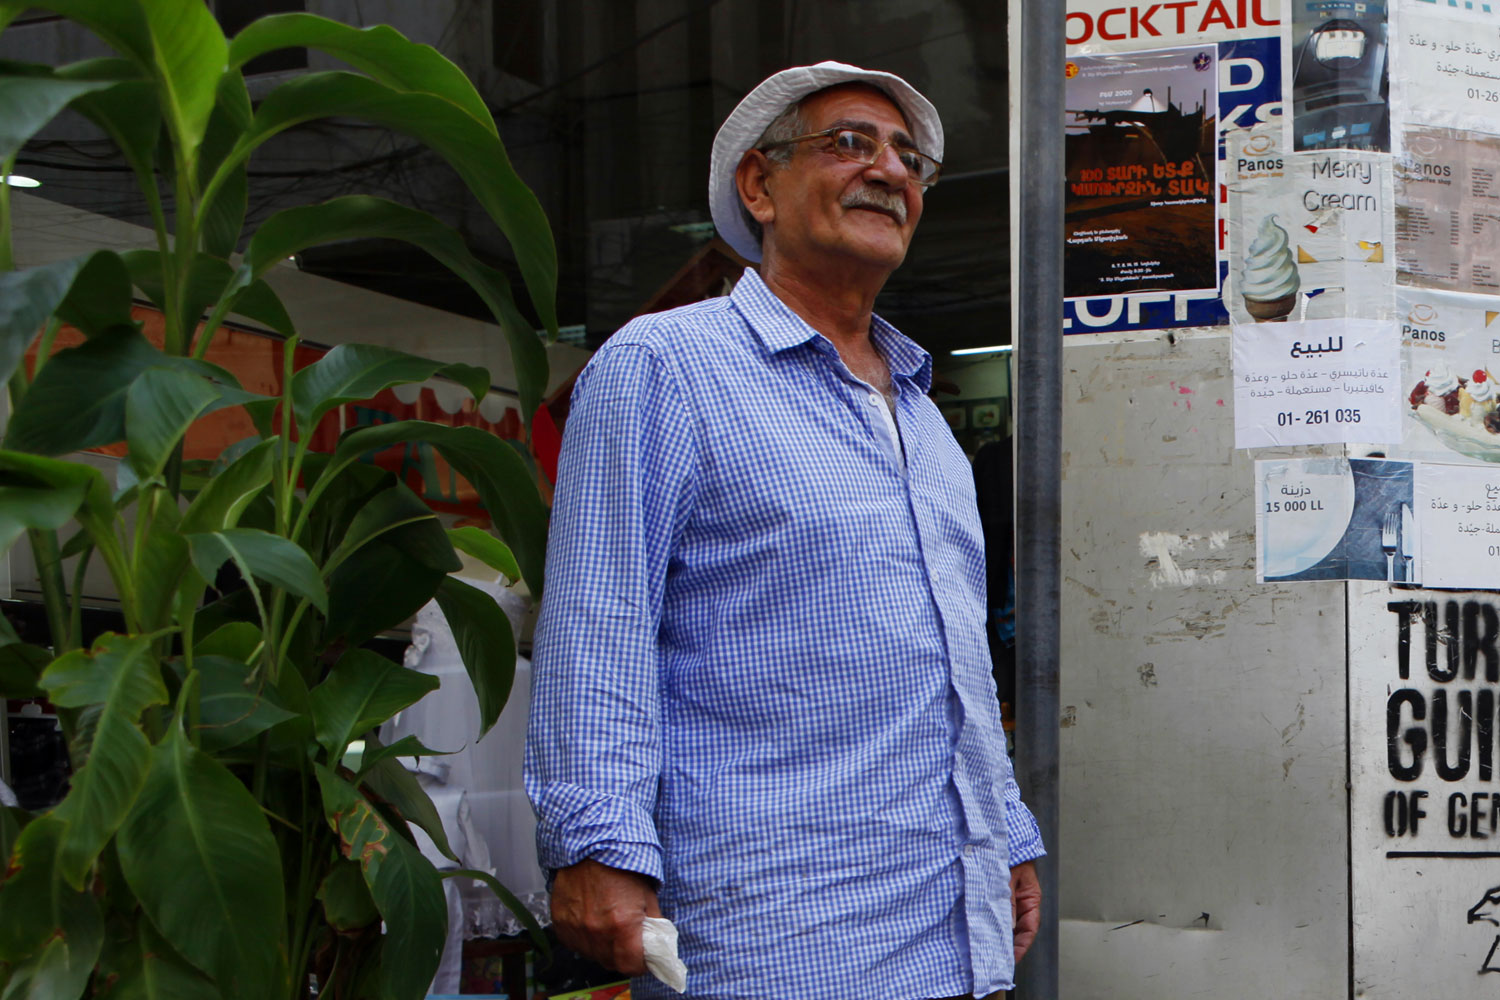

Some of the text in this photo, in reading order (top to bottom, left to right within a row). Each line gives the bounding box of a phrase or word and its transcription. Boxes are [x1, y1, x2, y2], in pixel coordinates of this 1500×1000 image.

[1065, 0, 1281, 44] OCKTAIL
[1238, 159, 1283, 172] Panos
[1312, 158, 1372, 184] Merry
[1404, 162, 1451, 177] anos
[1303, 190, 1376, 212] Cream
[1402, 325, 1446, 342] Panos
[1290, 336, 1343, 358] للبيع
[1281, 371, 1298, 383] حلو
[1277, 408, 1361, 426] 01- 261 035
[1266, 500, 1324, 512] 15 000 LL
[1385, 790, 1429, 838] OF
